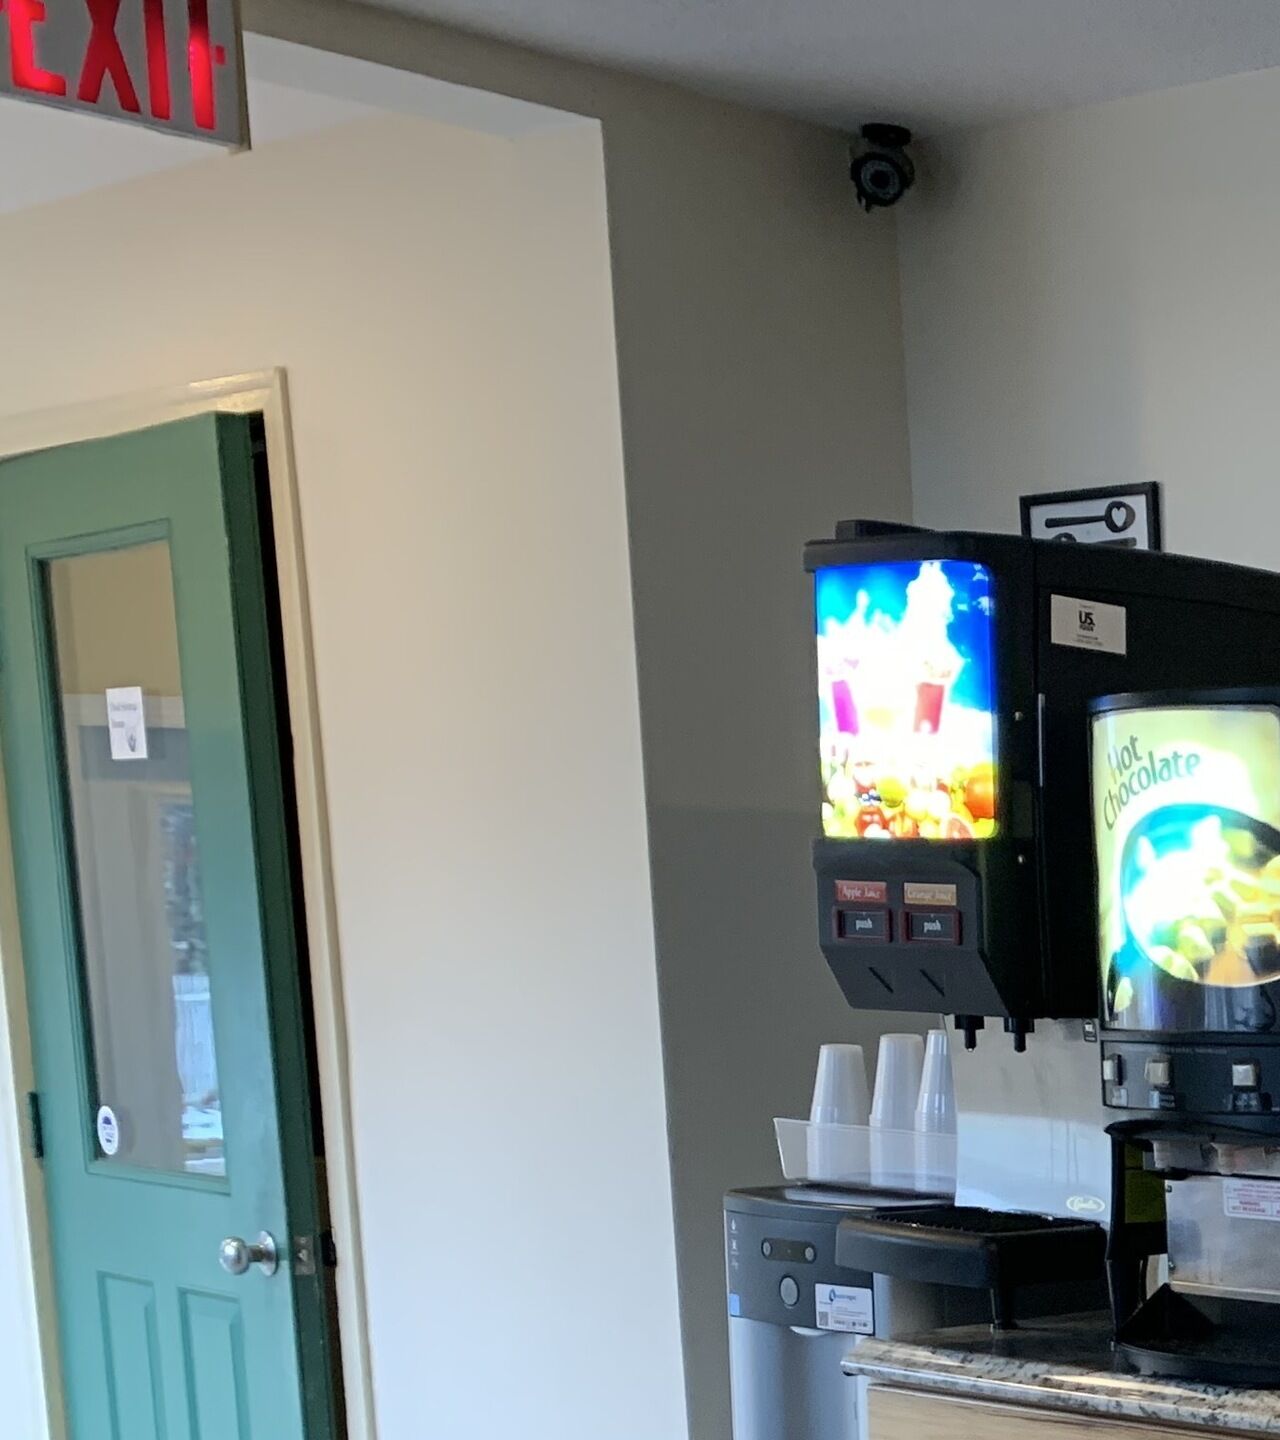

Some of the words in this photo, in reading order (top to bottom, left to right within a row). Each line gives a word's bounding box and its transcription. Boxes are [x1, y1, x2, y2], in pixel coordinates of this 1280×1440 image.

[8, 0, 216, 130] EXIT
[1107, 734, 1143, 784] Hot
[1103, 750, 1201, 831] Chocolate
[855, 918, 873, 931] push
[923, 919, 942, 933] push
